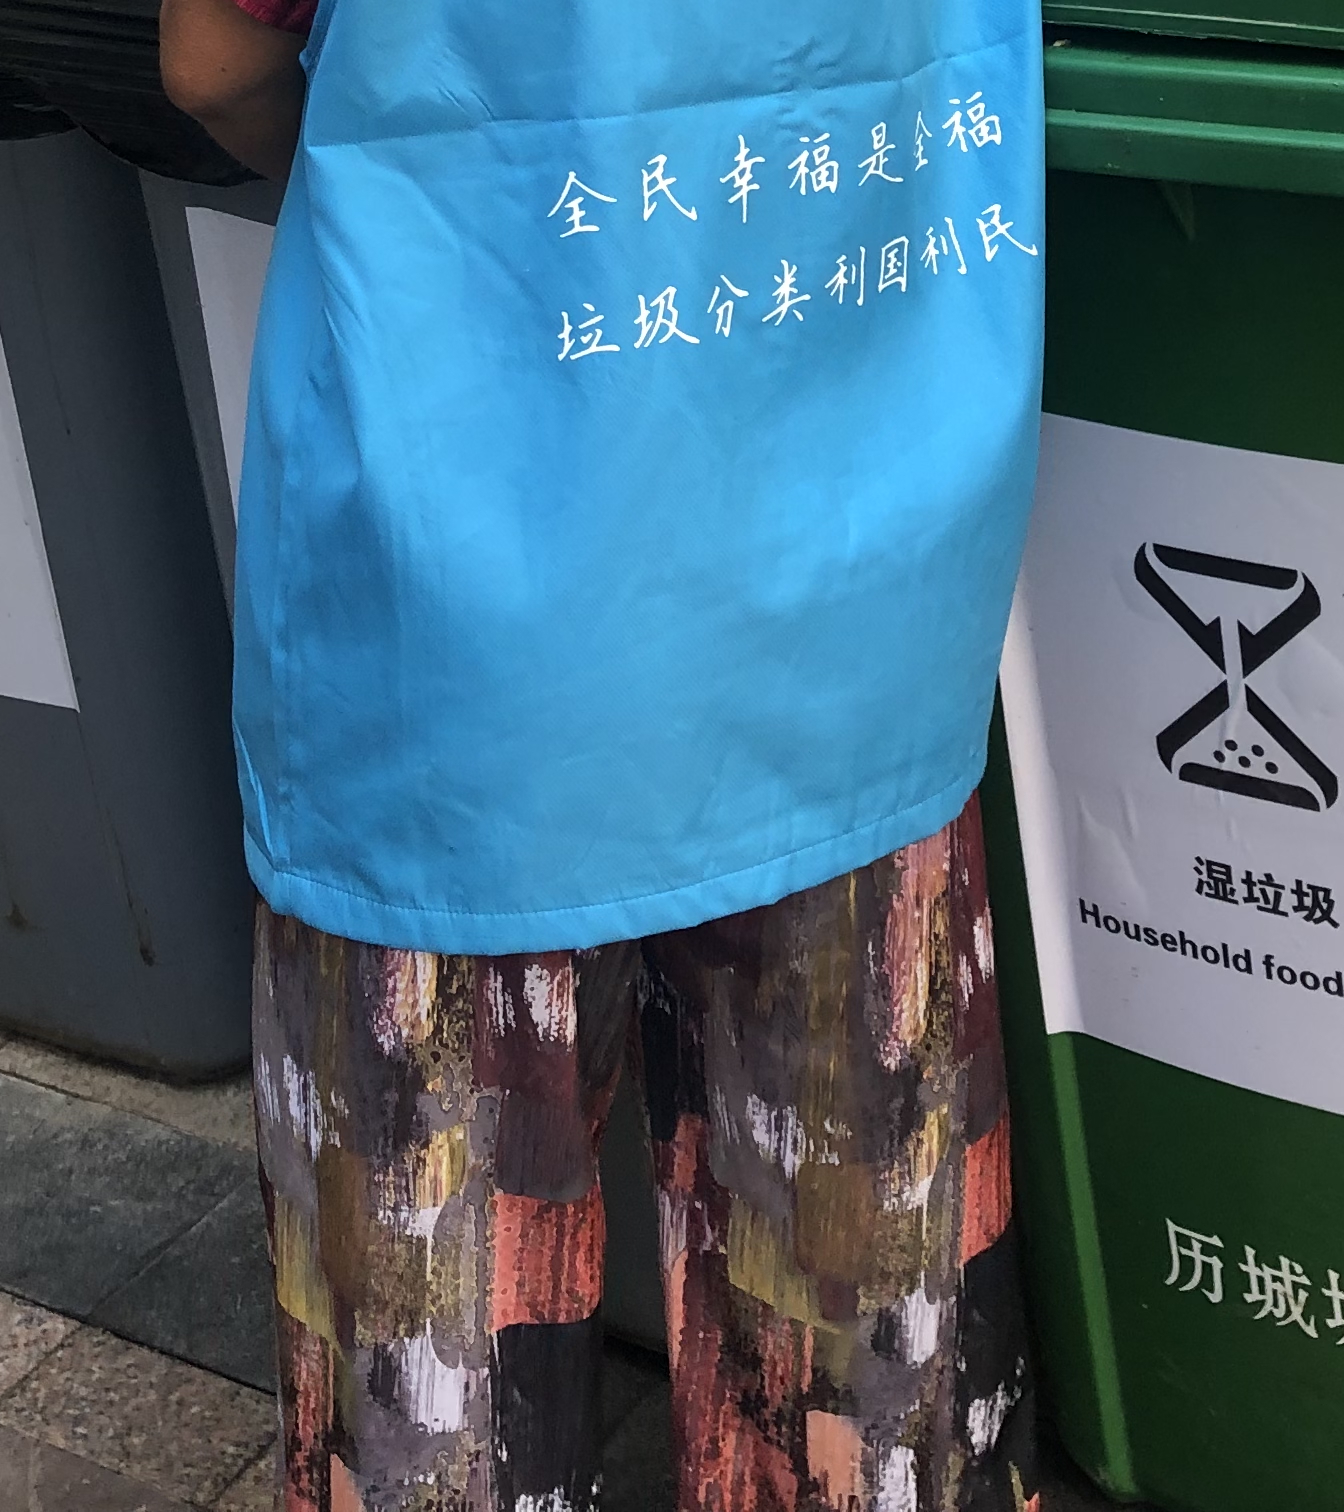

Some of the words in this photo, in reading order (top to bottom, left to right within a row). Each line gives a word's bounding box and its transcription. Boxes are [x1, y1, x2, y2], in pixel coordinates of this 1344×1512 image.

[547, 91, 1003, 238] 全民幸福是全福
[557, 203, 1039, 362] 垃圾分类利国利民
[1078, 897, 1254, 977] Household
[1192, 854, 1340, 930] 湿垃圾
